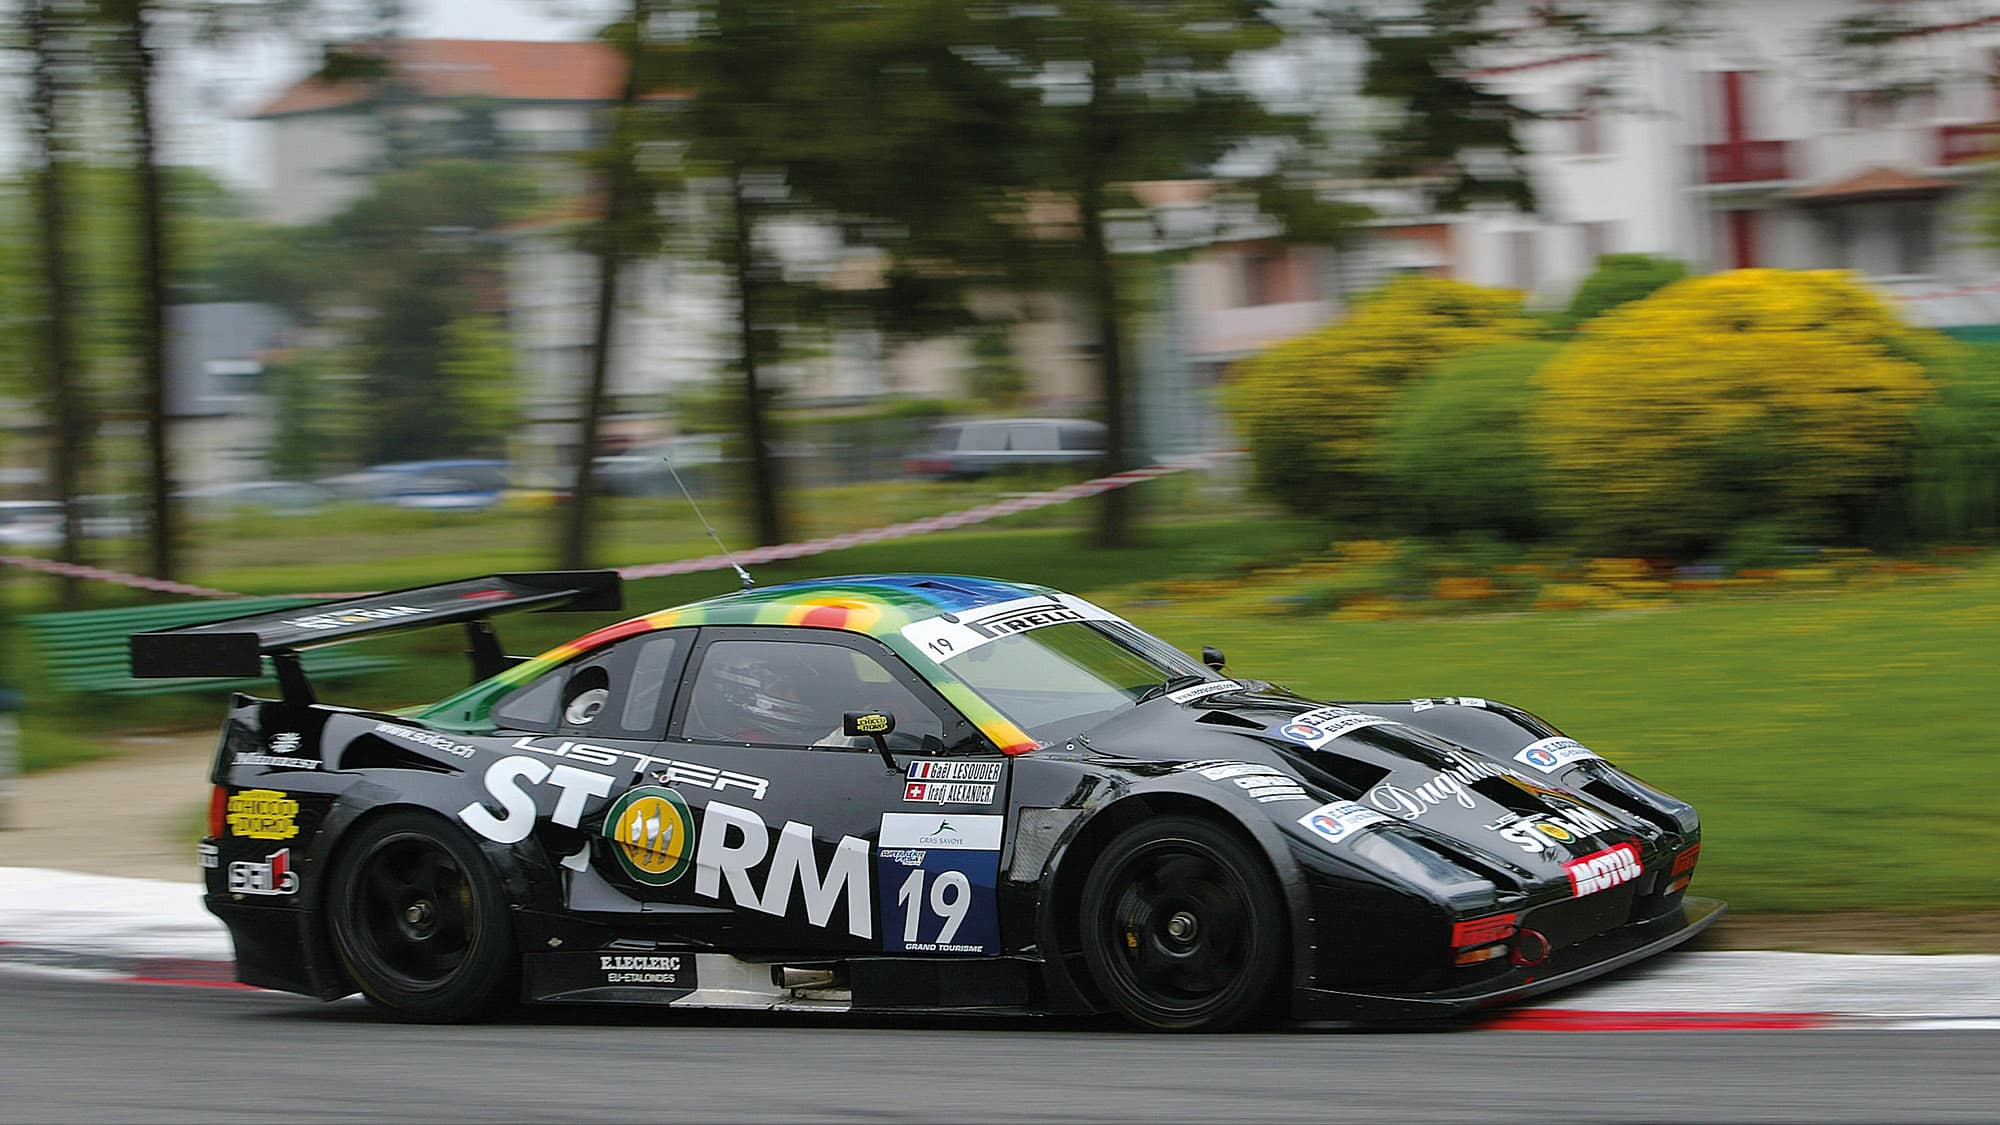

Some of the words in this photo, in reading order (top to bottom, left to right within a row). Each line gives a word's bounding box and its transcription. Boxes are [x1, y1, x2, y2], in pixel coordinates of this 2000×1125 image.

[963, 604, 1086, 639] PIRELLI
[928, 637, 955, 656] 19
[512, 736, 770, 800] LISTER
[931, 763, 952, 779] Gaël
[952, 763, 1001, 780] LESOUDIER
[928, 784, 947, 804] Iradj
[947, 785, 993, 803] ALEXANDER
[458, 755, 872, 940] STORM
[919, 836, 938, 844] GRAS
[938, 837, 963, 845] SAVOYE
[1571, 847, 1641, 897] MOTUL
[898, 868, 972, 944] 19
[905, 942, 937, 951] GRAND
[938, 943, 984, 953] TOURISME
[600, 956, 681, 970] E.LECLERC
[607, 972, 676, 984] EU-ETALONDES
